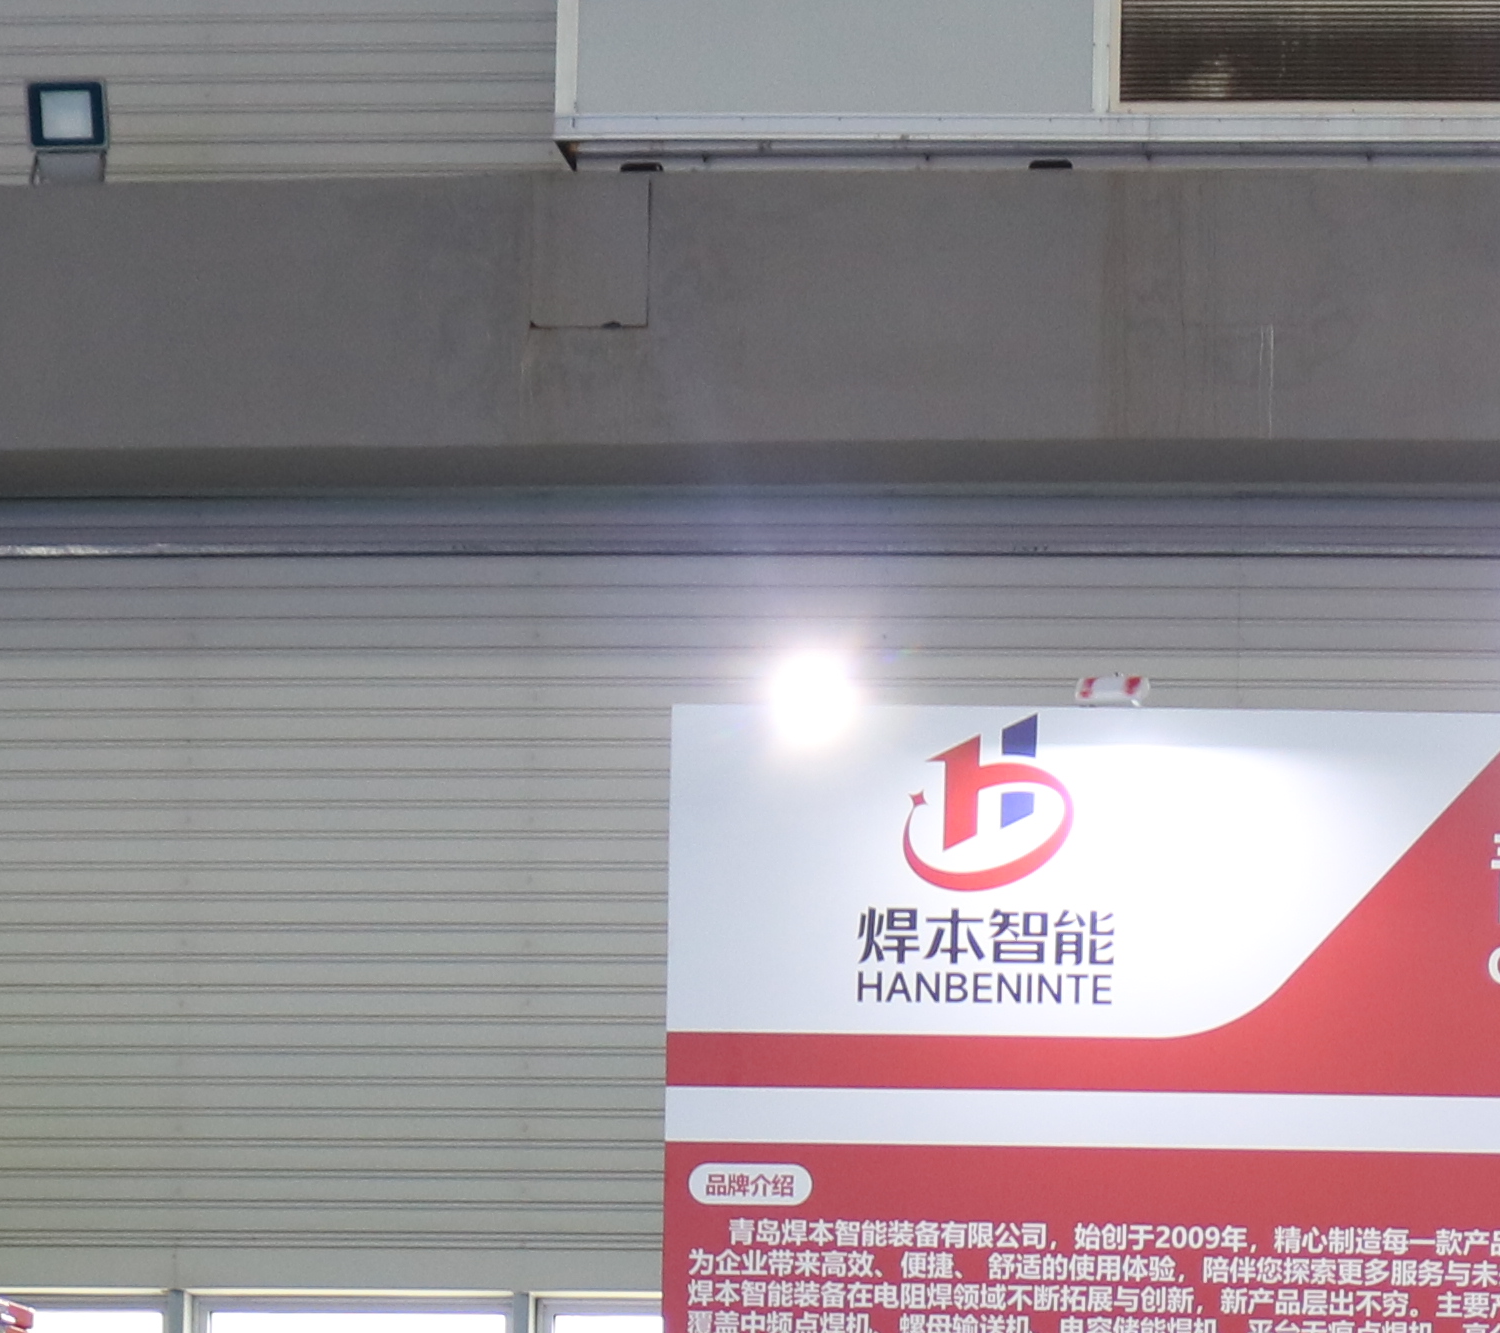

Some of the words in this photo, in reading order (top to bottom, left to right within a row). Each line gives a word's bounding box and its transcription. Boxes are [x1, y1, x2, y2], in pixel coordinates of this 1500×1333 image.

[857, 906, 1114, 966] 焊本智能
[857, 970, 1113, 1005] HANBENINTE
[705, 1173, 795, 1198] 品牌介绍
